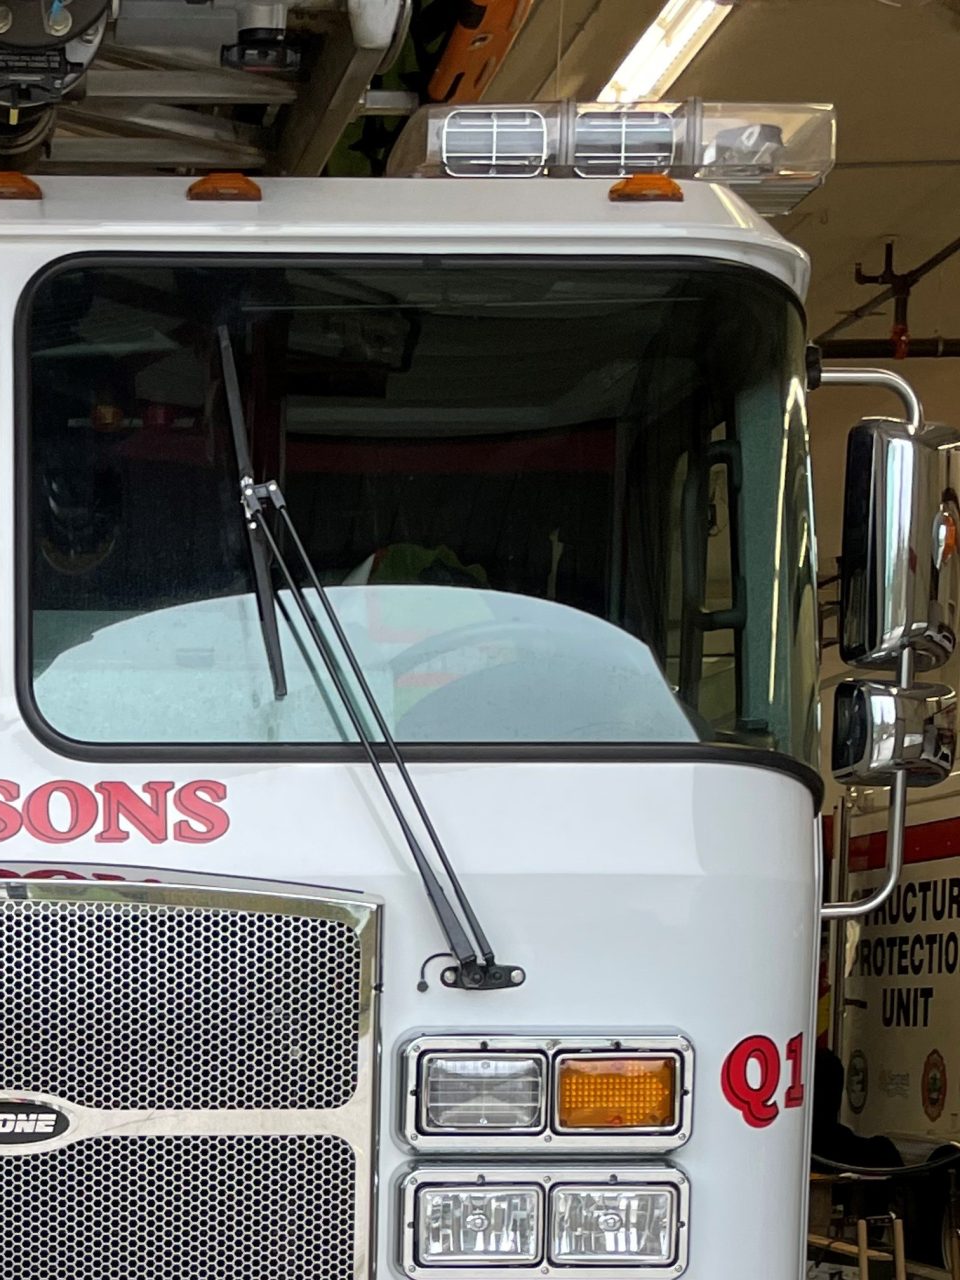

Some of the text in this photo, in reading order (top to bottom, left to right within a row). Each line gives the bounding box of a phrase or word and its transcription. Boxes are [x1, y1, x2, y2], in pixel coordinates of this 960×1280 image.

[846, 931, 960, 977] ROTECTIO
[882, 987, 934, 1028] UNIT
[720, 1032, 805, 1128] Q1
